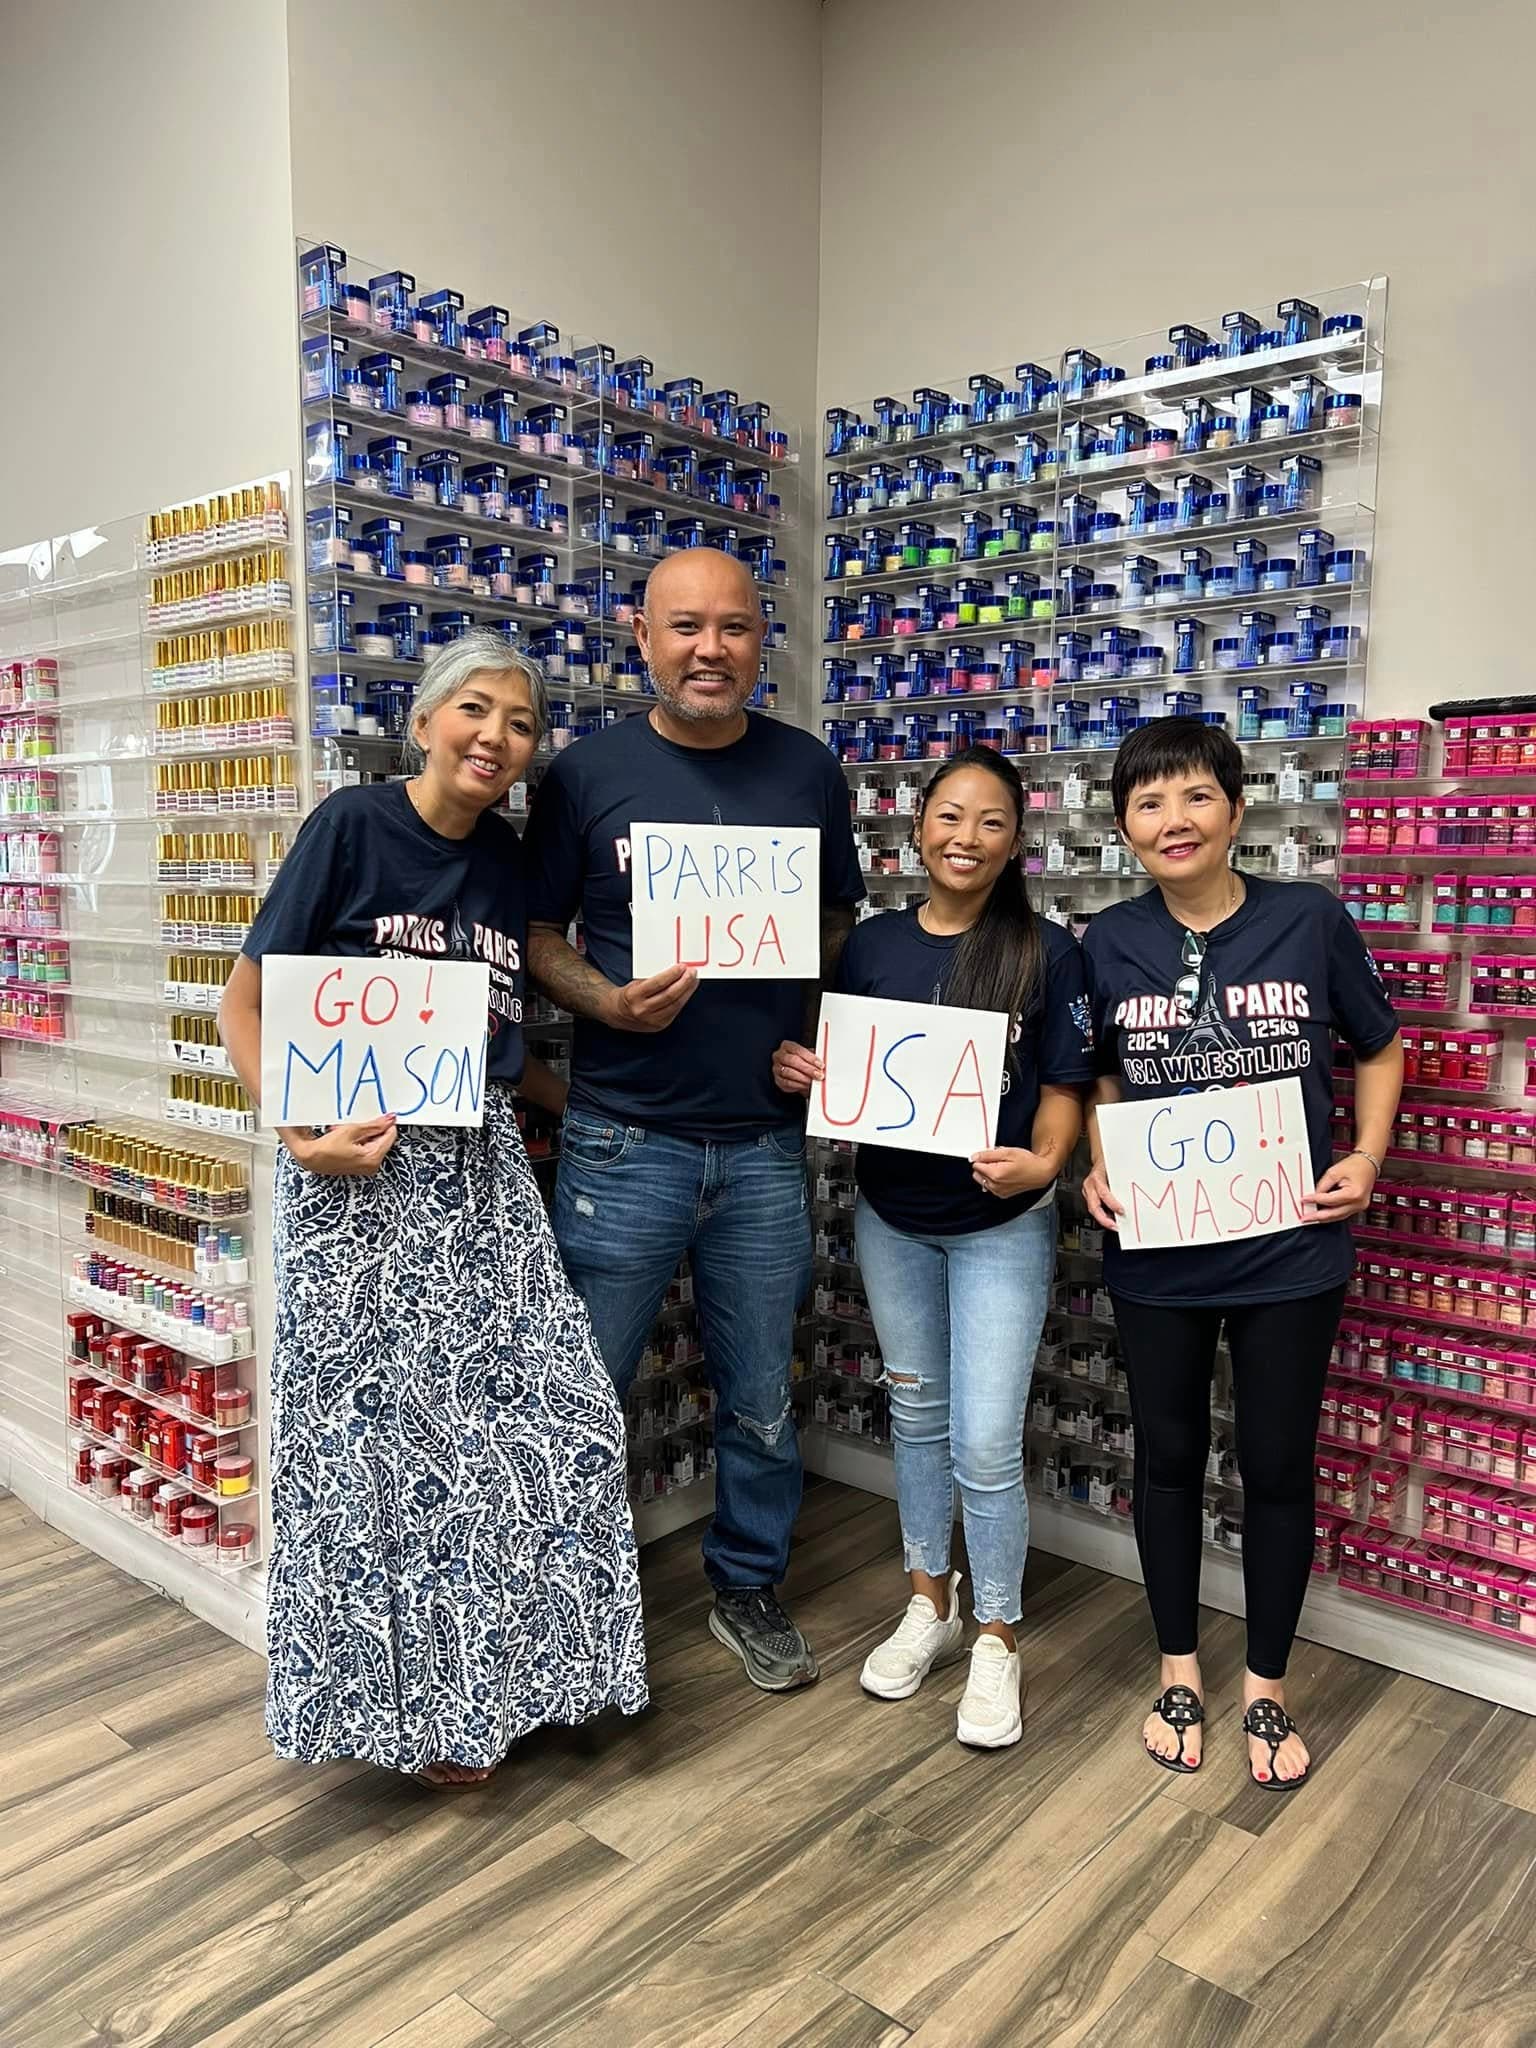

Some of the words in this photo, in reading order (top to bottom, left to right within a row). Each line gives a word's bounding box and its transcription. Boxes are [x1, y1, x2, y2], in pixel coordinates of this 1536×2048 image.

[374, 914, 447, 953] PARRIS
[472, 922, 520, 971] PARIS
[676, 913, 786, 968] USA
[1114, 994, 1195, 1030] PARRIS
[1225, 981, 1311, 1018] PARIS
[1124, 1057, 1162, 1085] USA
[1161, 1039, 1311, 1084] WRESTLING
[1127, 1031, 1170, 1051] 2024
[282, 1031, 487, 1120] MASON
[821, 1021, 991, 1148] USA
[1131, 1152, 1306, 1243] MASON
